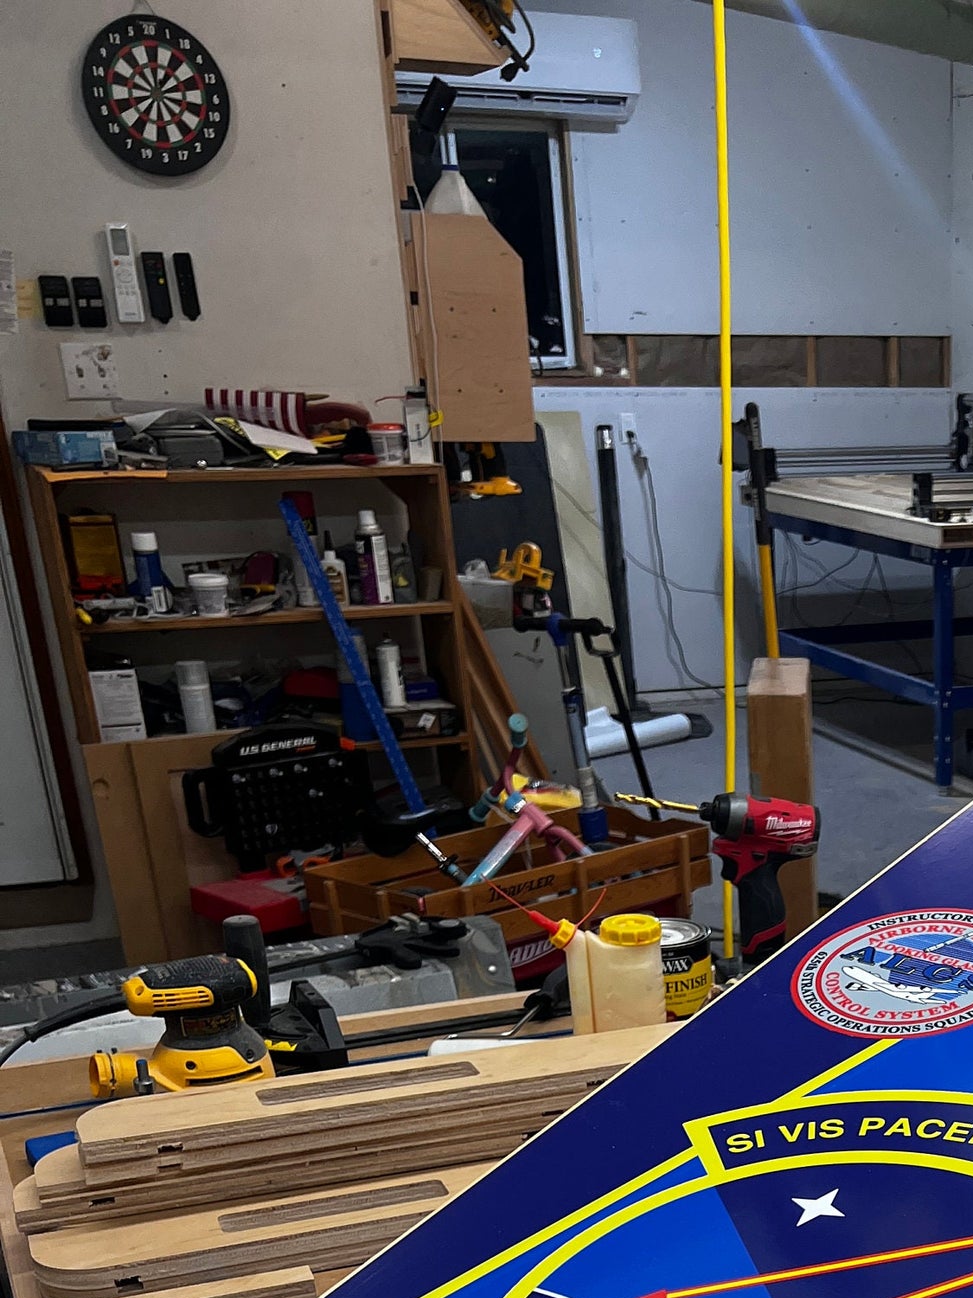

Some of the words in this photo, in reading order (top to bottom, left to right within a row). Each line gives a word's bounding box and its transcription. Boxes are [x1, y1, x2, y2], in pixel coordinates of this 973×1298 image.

[127, 26, 134, 36] 5
[142, 24, 156, 36] 20
[165, 29, 170, 39] 1
[109, 33, 121, 44] 12
[179, 38, 191, 50] 18
[100, 47, 107, 58] 9
[195, 54, 203, 64] 4
[92, 66, 104, 77] 14
[204, 73, 216, 84] 13
[93, 87, 104, 98] 11
[212, 94, 219, 105] 6
[101, 105, 108, 115] 8
[208, 111, 221, 122] 10
[108, 122, 120, 134] 16
[203, 128, 215, 139] 15
[125, 139, 132, 149] 7
[194, 142, 202, 153] 2
[141, 148, 153, 160] 19
[162, 152, 170, 163] 3
[177, 150, 189, 161] 17
[261, 736, 317, 753] GENERAL
[867, 912, 973, 931] INSTRUCTOR
[867, 924, 966, 946] AIRBORNE
[510, 939, 553, 965] ADIO
[871, 940, 940, 963] LOOKING
[662, 958, 688, 973] WAX
[805, 951, 828, 971] 625th
[665, 973, 708, 993] FINISH
[800, 971, 831, 1018] STRATEGIC
[825, 971, 870, 1017] CONTROL
[874, 1001, 960, 1020] SYSTEM
[826, 1014, 921, 1034] OPERATIONS
[726, 1129, 766, 1155] SI
[777, 1118, 846, 1145] VIS
